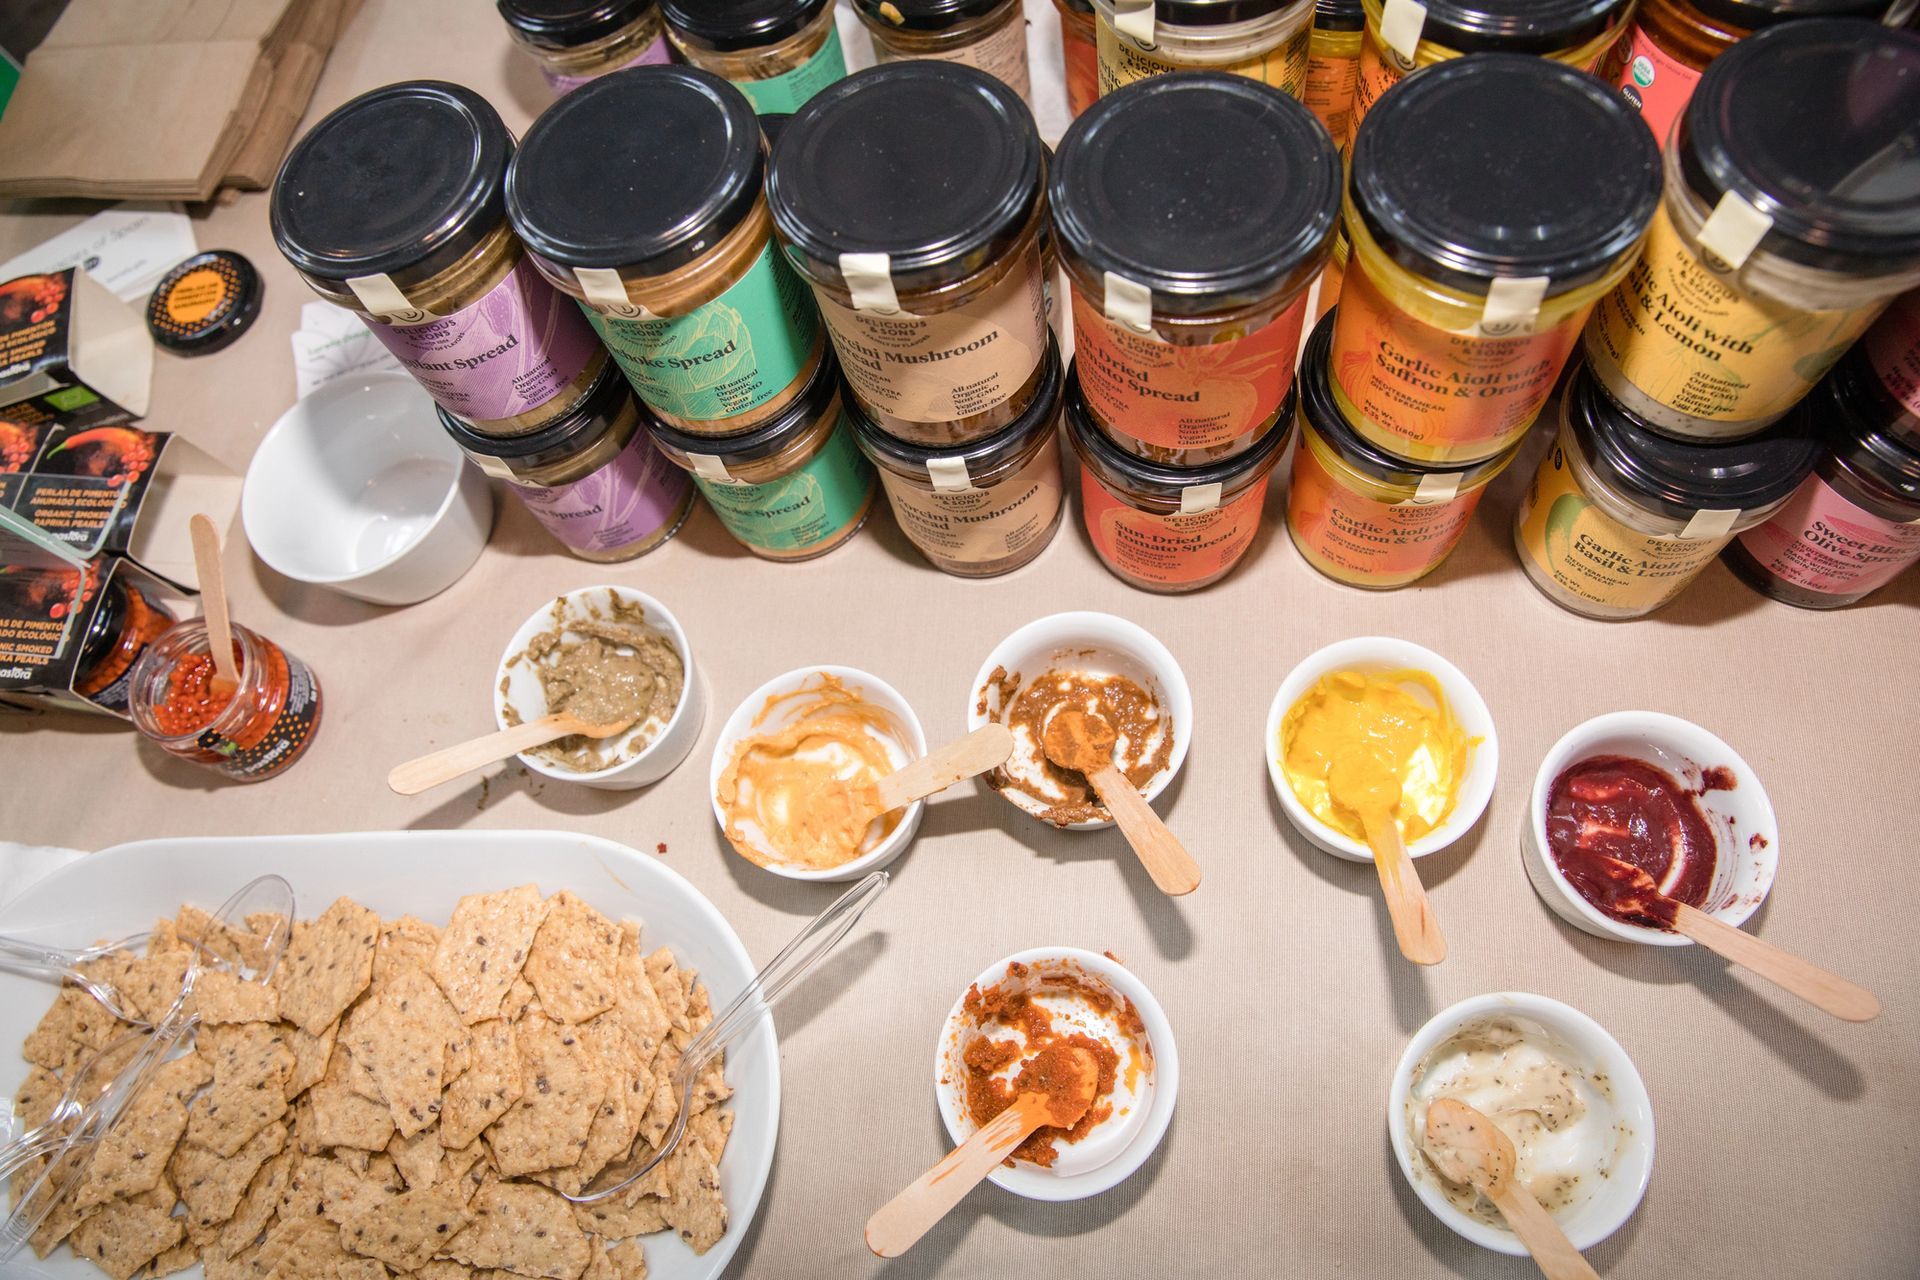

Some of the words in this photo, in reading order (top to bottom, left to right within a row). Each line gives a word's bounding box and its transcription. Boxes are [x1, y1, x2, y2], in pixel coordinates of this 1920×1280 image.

[1136, 63, 1163, 77] SON
[1623, 87, 1642, 109] GLUTEN
[393, 319, 457, 335] DELICIOUS
[856, 316, 927, 330] DELICIOUS
[880, 327, 916, 337] SONS
[1640, 294, 1656, 313] &
[1653, 311, 1723, 362] Lemon
[1656, 292, 1702, 332] Aioli
[1703, 325, 1754, 355] with
[418, 329, 451, 341] SONS
[453, 334, 519, 370] Spread
[668, 340, 737, 370] Spread
[884, 330, 999, 365] Mushroom
[511, 375, 524, 386] All
[523, 356, 552, 379] natural
[1379, 341, 1441, 378] Garlic
[1446, 371, 1500, 386] Aioli
[515, 369, 547, 391] Organic
[519, 367, 559, 394] Non-GMO
[714, 384, 726, 393] All
[727, 368, 759, 389] natural
[952, 385, 965, 394] All
[966, 371, 999, 390] natural
[1376, 353, 1449, 395] Saffron
[1453, 386, 1472, 398] &
[1689, 376, 1732, 393] Organic
[1694, 371, 1710, 380] All
[1710, 376, 1751, 389] natural
[522, 385, 548, 400] Vegan
[527, 375, 569, 406] Gluten-free
[716, 380, 751, 397] Organic
[720, 380, 763, 403] Non-GMO
[952, 384, 989, 400] Organic
[954, 384, 1000, 405] Non-GMO
[1128, 378, 1200, 402] Spread
[1370, 380, 1384, 393] DIP
[1393, 396, 1429, 414] SPREAD
[1371, 374, 1446, 413] MEDITERRANEAN
[1681, 387, 1711, 403] Vegan
[1684, 382, 1739, 401] Non-GMO
[722, 395, 749, 408] Vegan
[725, 388, 773, 413] Gluten-free
[955, 399, 983, 410] Vegan
[956, 392, 1007, 415] Gluten-free
[1676, 394, 1736, 412] Gluten-free
[1178, 421, 1217, 430] Organic
[1178, 423, 1228, 434] Non-GMO
[1195, 411, 1231, 423] natural
[1178, 432, 1232, 445] Gluten-free
[754, 496, 811, 519] Spread
[930, 491, 991, 501] DELICIOUS
[953, 484, 1039, 524] Mushroom
[548, 504, 603, 520] Spread
[1163, 510, 1224, 523] DELICIOUS
[1184, 517, 1213, 527] SONS
[1332, 508, 1384, 534] Garlic
[1387, 524, 1429, 536] Aioli
[1115, 520, 1201, 544] Sun-Dried
[1117, 530, 1178, 553] Tomato
[1182, 526, 1237, 552] Spread
[1329, 516, 1390, 544] Saffron
[1393, 536, 1408, 545] &
[1812, 521, 1867, 550] Sweet
[1580, 533, 1633, 565] Garlic
[1634, 559, 1686, 570] Aioli
[1795, 540, 1863, 569] MEDITERRANEAN
[1804, 530, 1851, 557] Olive
[1574, 541, 1615, 569] Basil
[1616, 565, 1634, 576] &
[1813, 557, 1847, 570] SPREAD
[1566, 555, 1630, 586] MEDITERRANEAN
[14, 655, 49, 665] PEARLS
[16, 643, 53, 654] SMOKED
